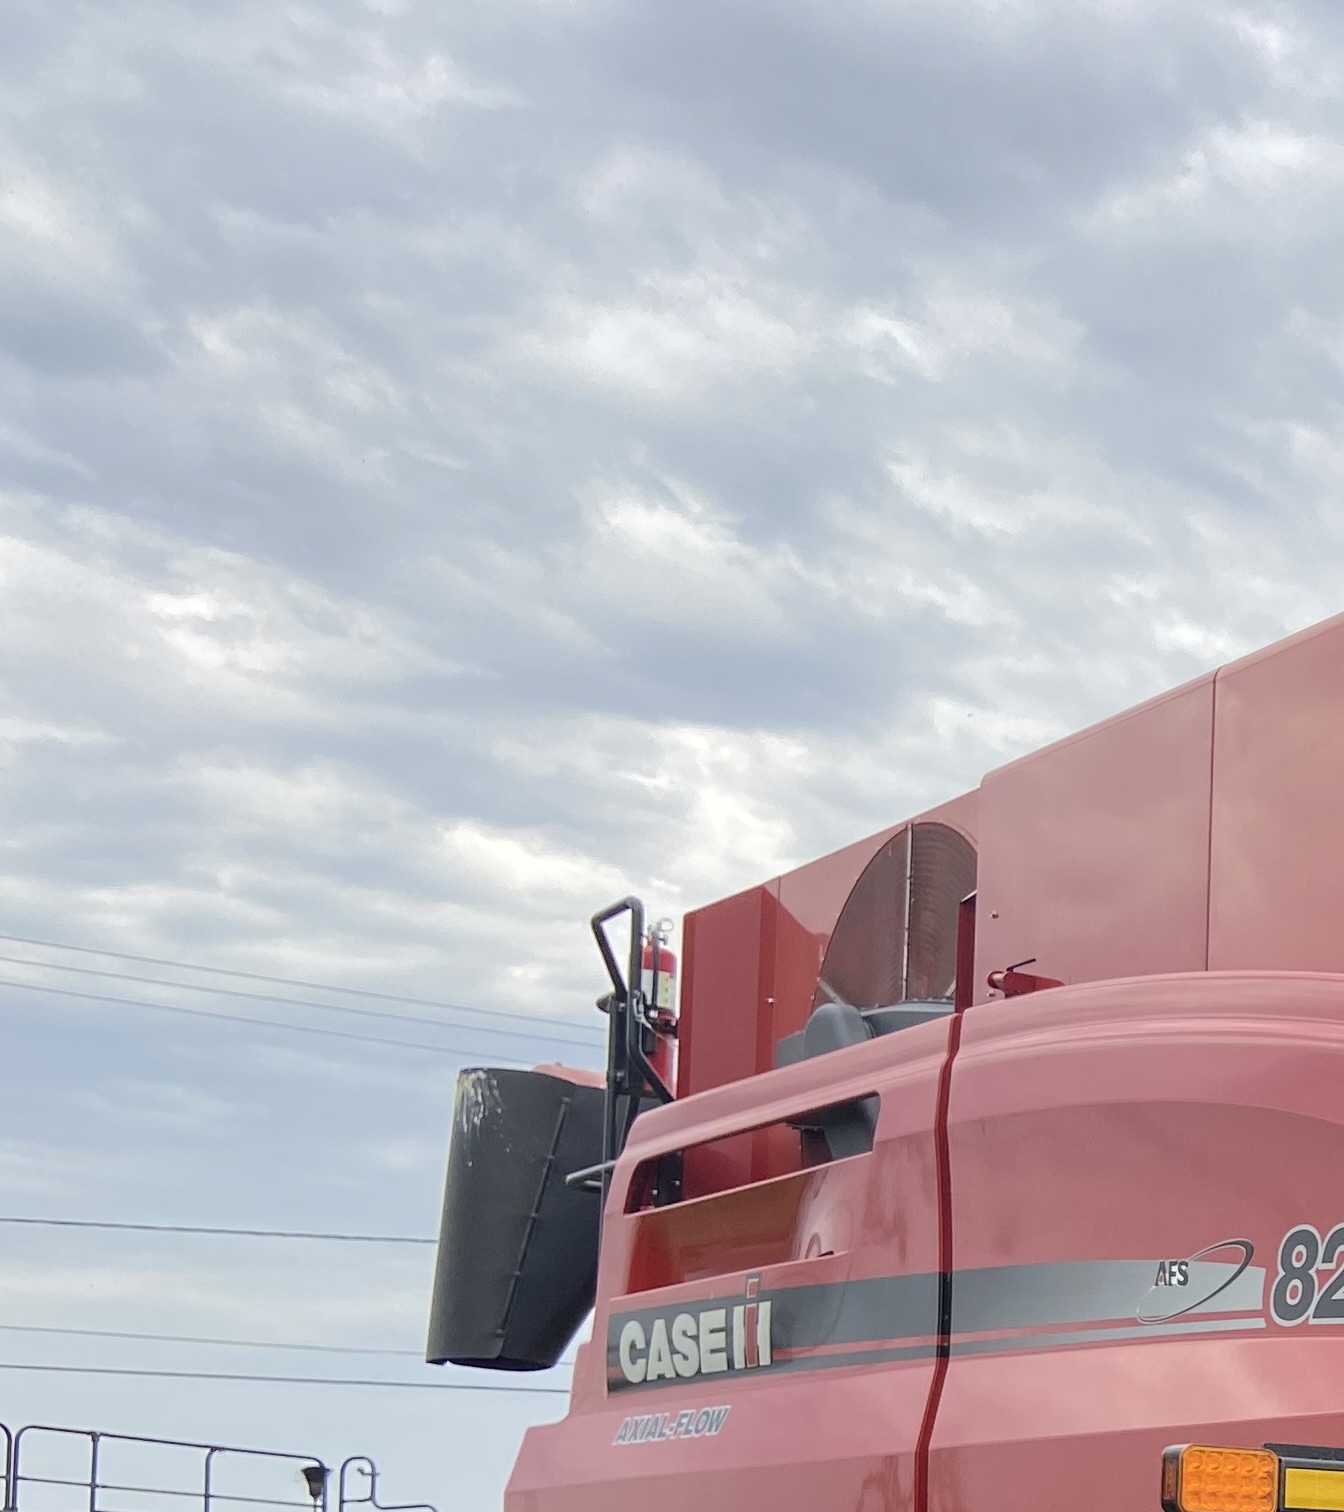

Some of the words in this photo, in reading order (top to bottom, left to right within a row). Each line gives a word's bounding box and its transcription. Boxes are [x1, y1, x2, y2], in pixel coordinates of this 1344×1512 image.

[1155, 1261, 1189, 1287] AFS
[619, 1312, 728, 1383] CASE
[612, 1405, 732, 1446] AXIAL-FLOW
